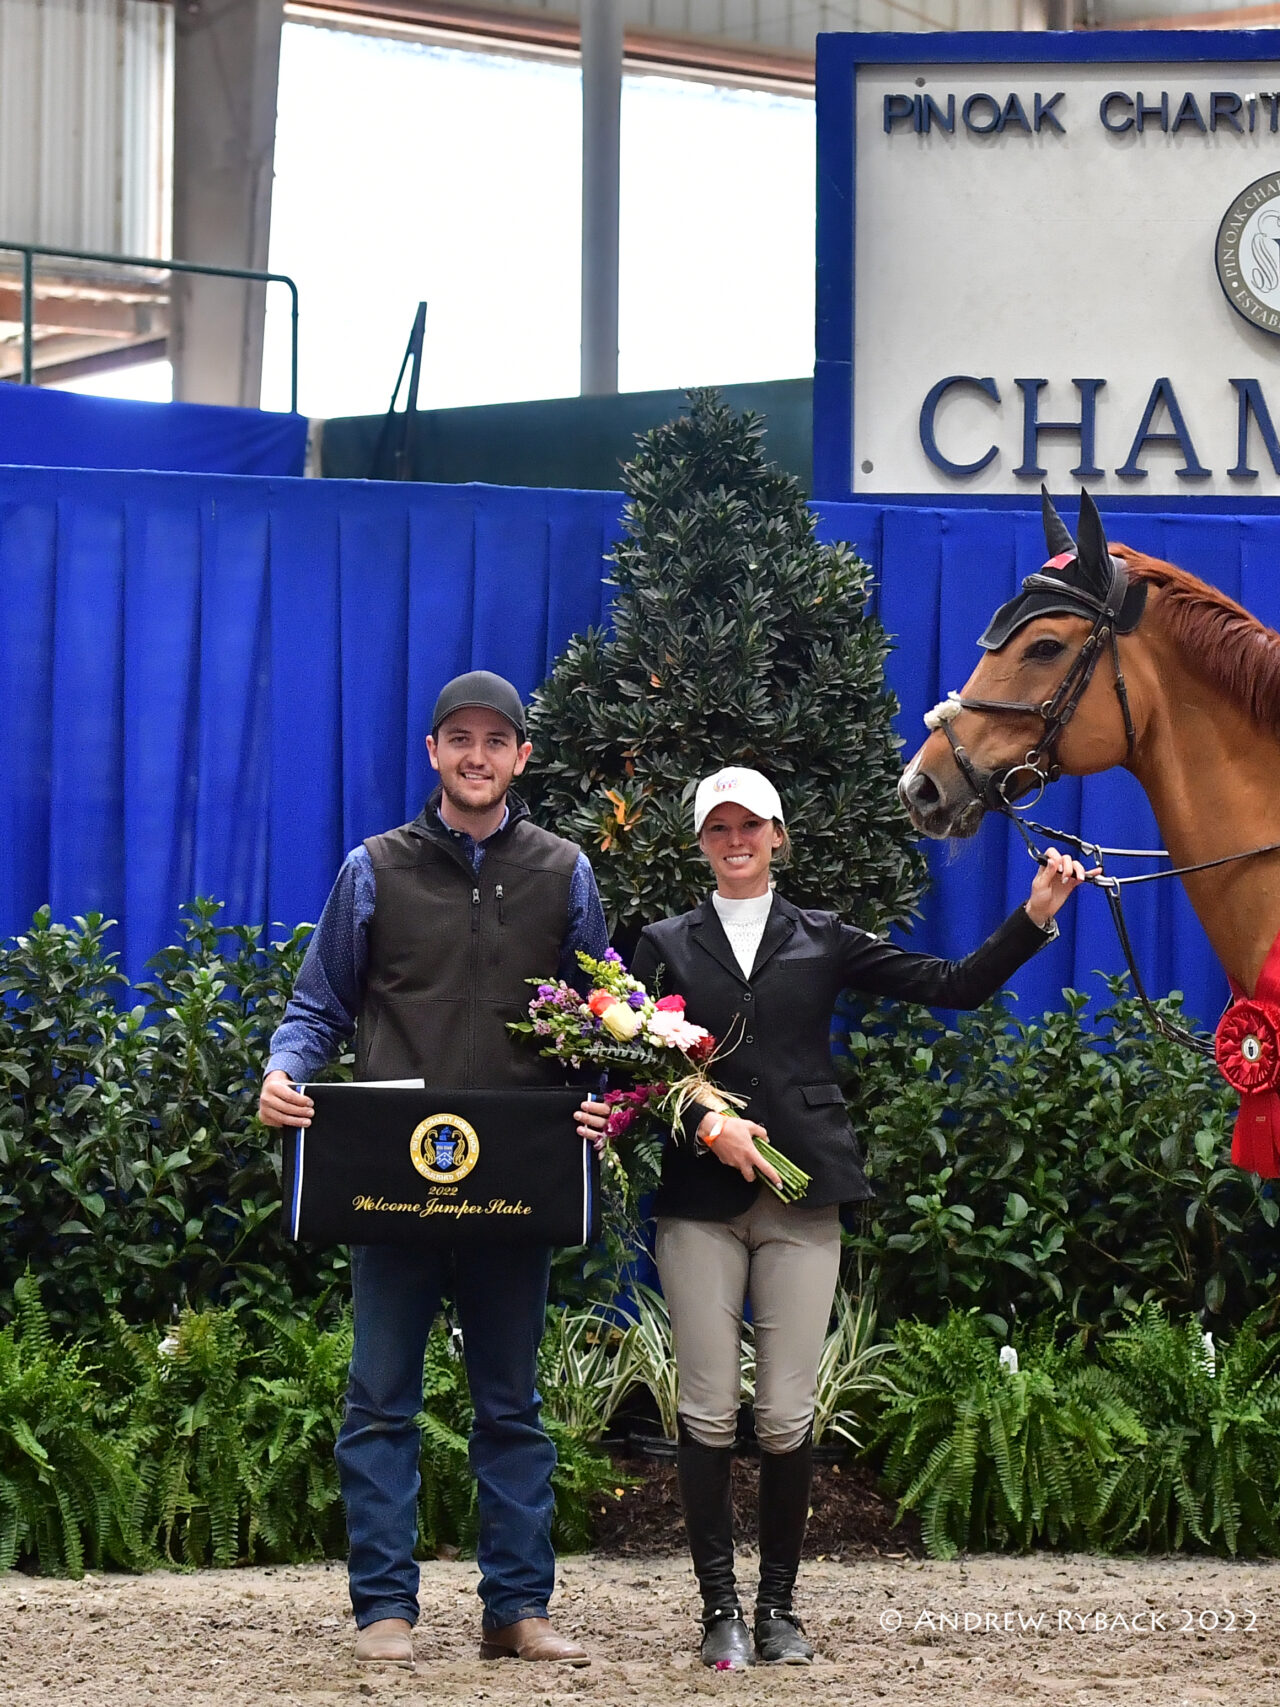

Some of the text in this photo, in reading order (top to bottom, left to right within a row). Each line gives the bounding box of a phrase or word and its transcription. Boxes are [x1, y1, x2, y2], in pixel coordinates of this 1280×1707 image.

[1226, 210, 1248, 243] OAK
[1224, 250, 1237, 277] PIN
[427, 1186, 459, 1196] 2022
[352, 1195, 533, 1219] Welcome Jumper Stake
